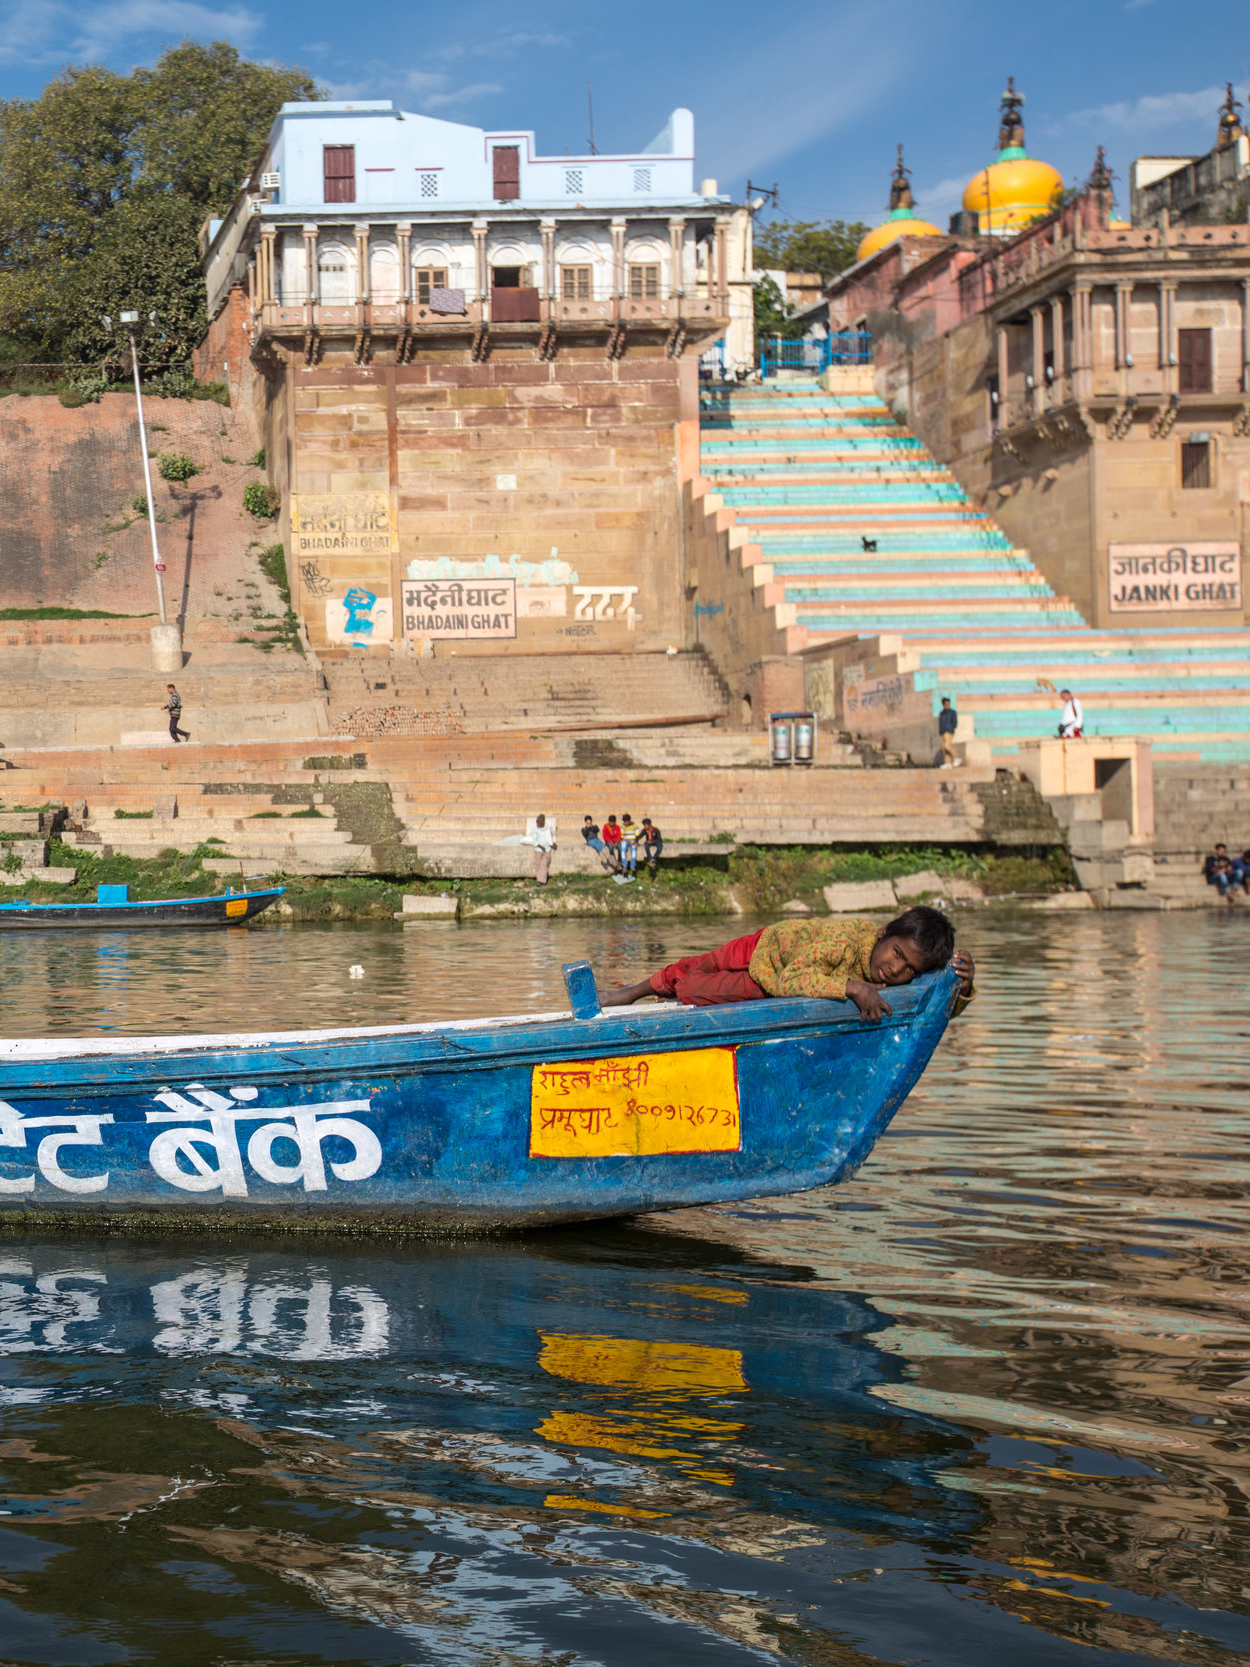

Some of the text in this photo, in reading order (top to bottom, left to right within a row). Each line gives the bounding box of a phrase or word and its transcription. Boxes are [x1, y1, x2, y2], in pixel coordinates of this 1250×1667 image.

[1113, 548, 1237, 575] जानकी घाट
[405, 583, 510, 611] भदैनी घाट
[1114, 583, 1239, 602] JANKI GHAT
[406, 613, 512, 631] BHADAINI GHAT
[538, 1070, 592, 1096] राहुल
[146, 1083, 383, 1197] बैंक
